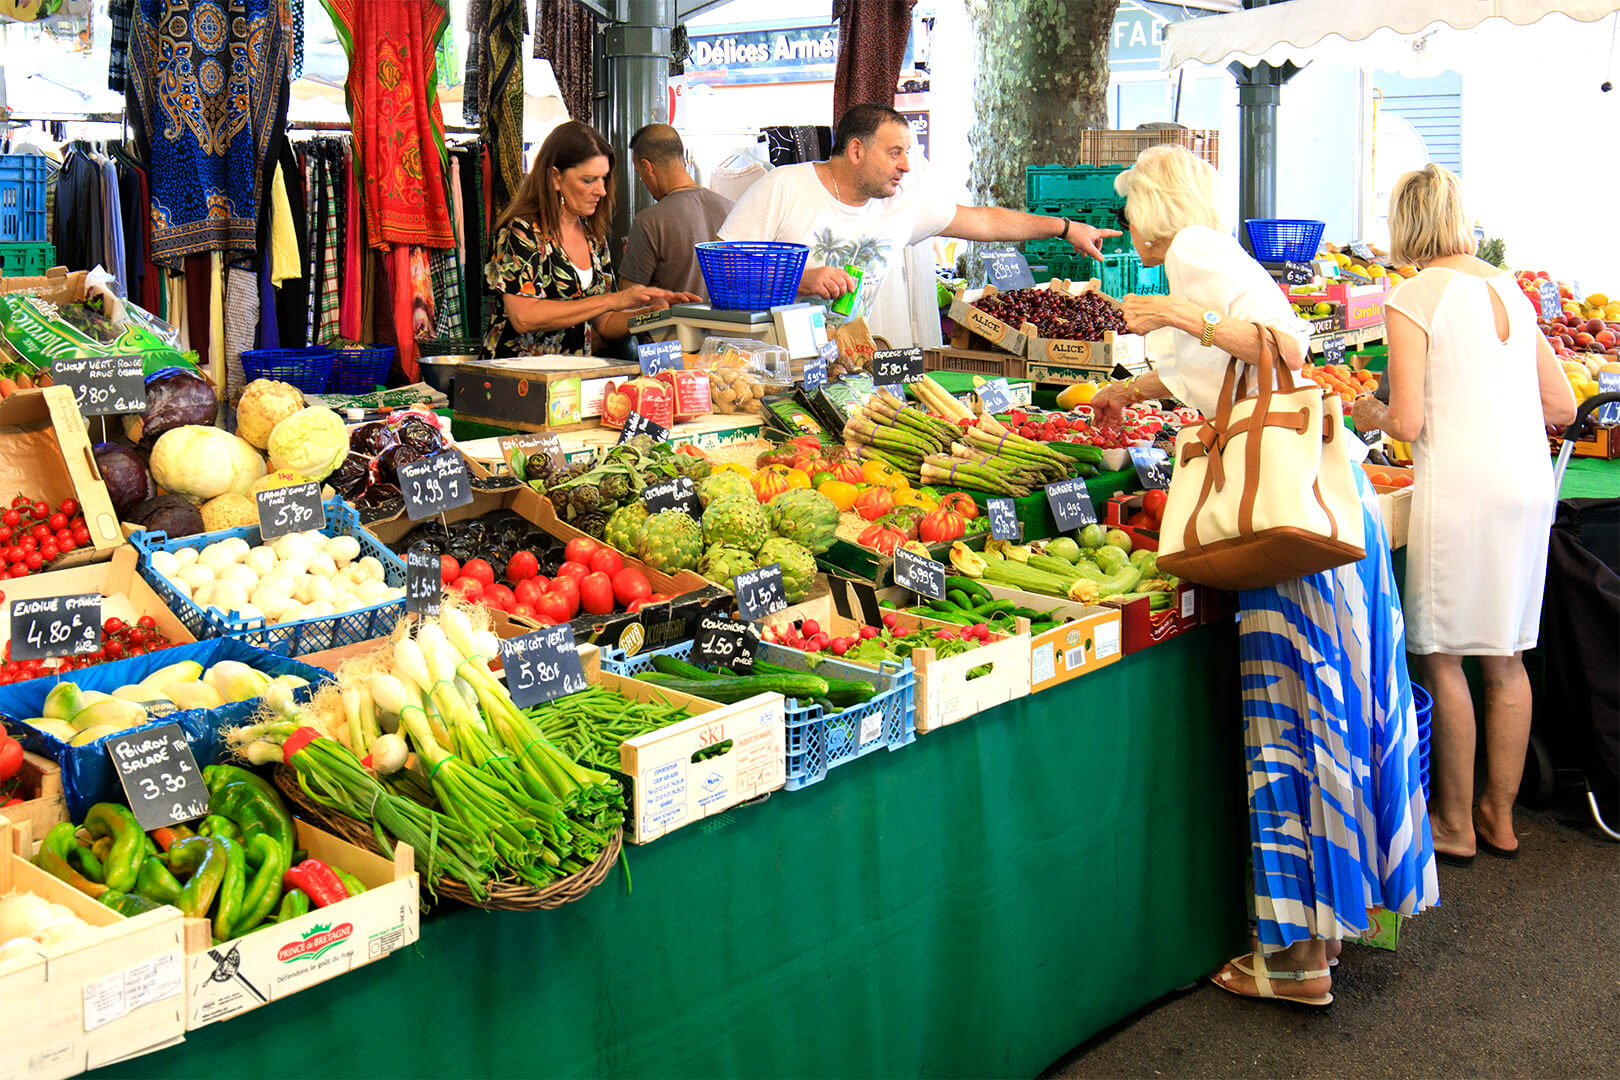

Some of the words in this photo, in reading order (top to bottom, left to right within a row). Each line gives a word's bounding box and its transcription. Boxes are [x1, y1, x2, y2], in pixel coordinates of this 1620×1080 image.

[697, 38, 769, 65] Délices
[972, 313, 1001, 333] ALICE
[1053, 343, 1085, 354] ALICE
[412, 478, 444, 505] 2.99
[699, 724, 725, 748] SKI
[279, 943, 306, 960] PRINCE
[313, 924, 352, 948] BRETAGNE
[277, 967, 309, 983] Défendons
